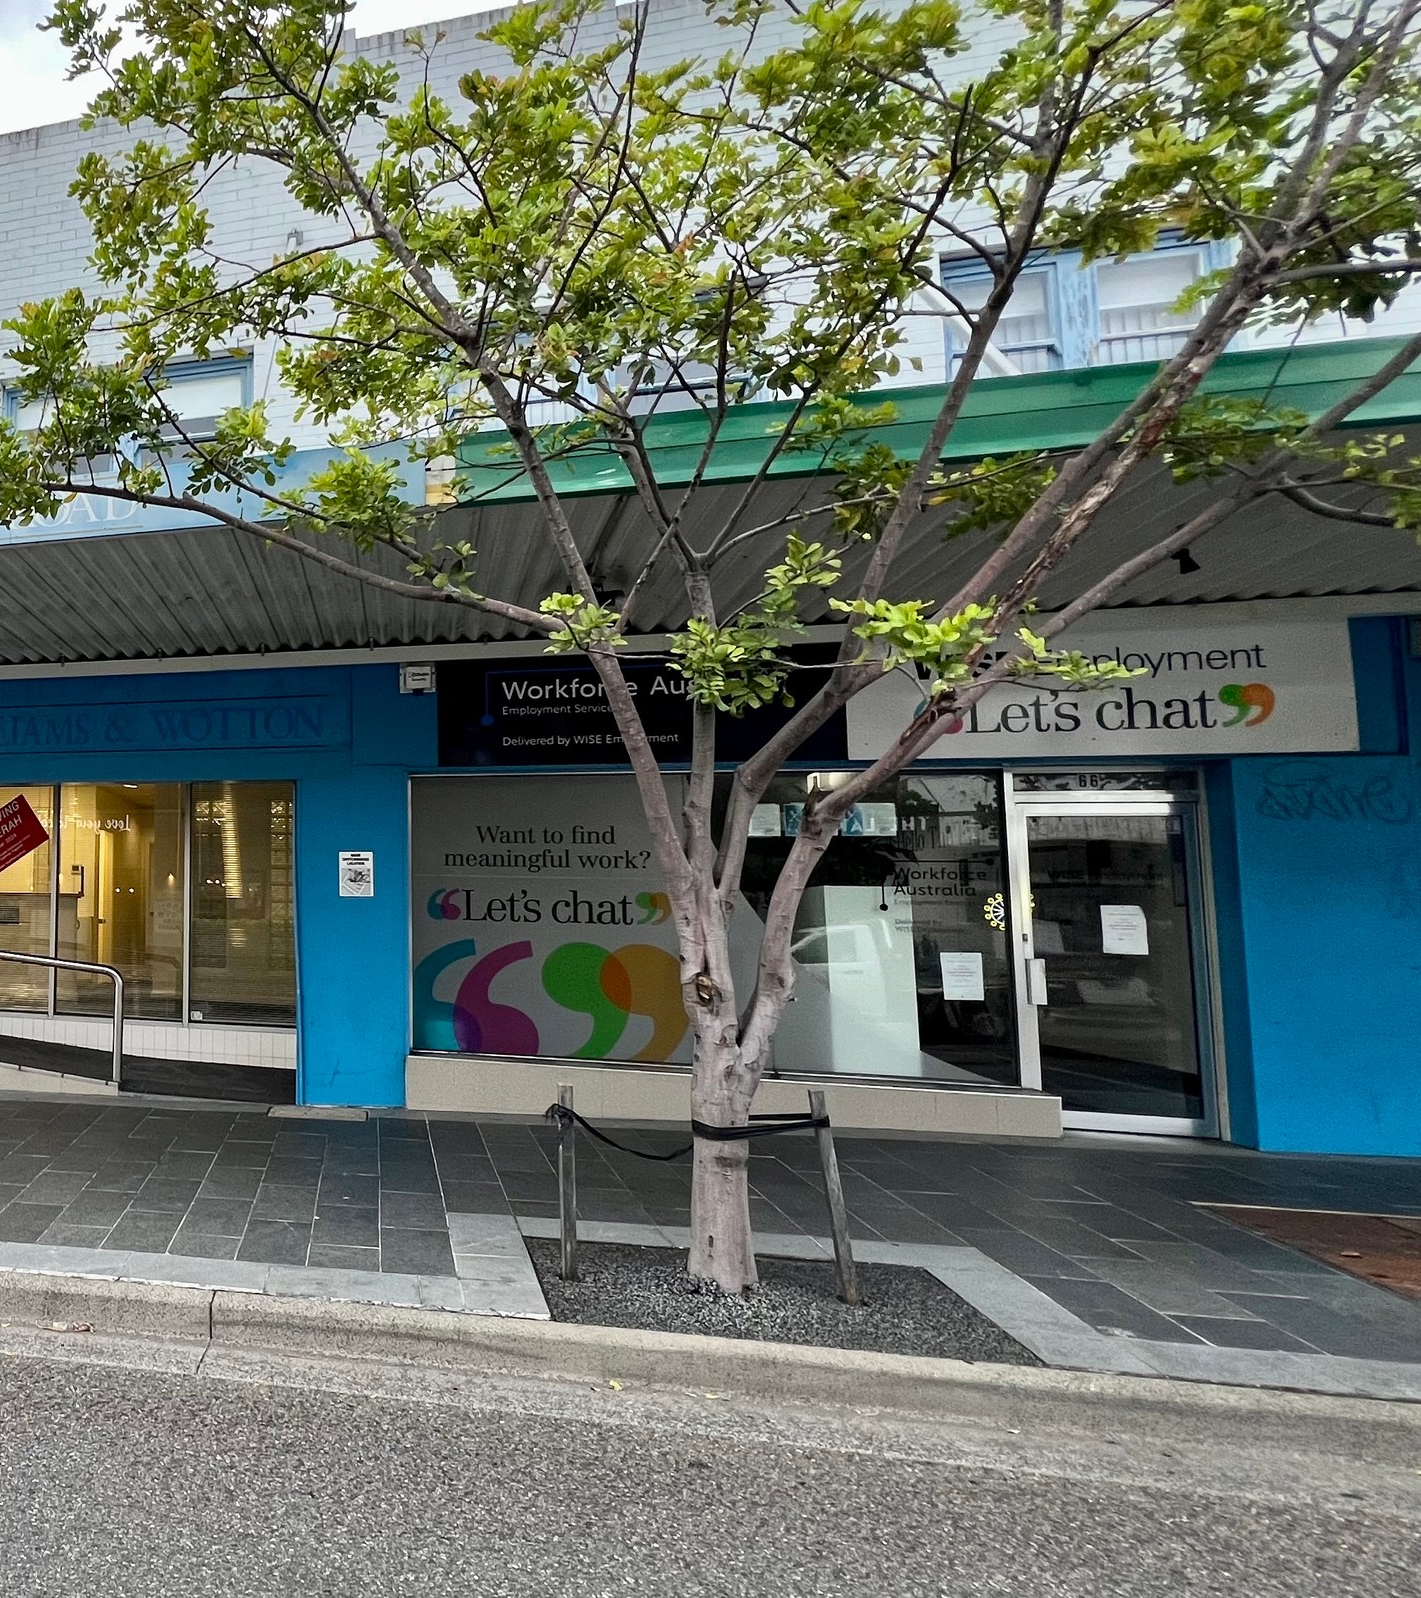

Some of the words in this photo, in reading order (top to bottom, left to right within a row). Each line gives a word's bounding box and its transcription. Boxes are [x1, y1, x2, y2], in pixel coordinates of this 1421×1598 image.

[502, 678, 638, 700] Workfore
[502, 705, 571, 717] Employment
[964, 690, 1081, 734] Let's
[1095, 686, 1218, 731] chat
[104, 710, 134, 744] &
[150, 702, 324, 742] WOTTON
[502, 736, 554, 746] Delivered
[557, 735, 571, 747] by
[573, 735, 603, 744] WISE
[606, 733, 679, 744] Emment
[1079, 774, 1099, 788] 66
[476, 825, 536, 844] Want
[543, 827, 564, 845] to
[571, 824, 617, 845] find
[444, 849, 571, 873] meaningful
[578, 850, 652, 870] work?
[894, 867, 987, 880] Workforce
[893, 883, 977, 896] Australia
[461, 888, 543, 924] Let's
[550, 889, 634, 926] chat
